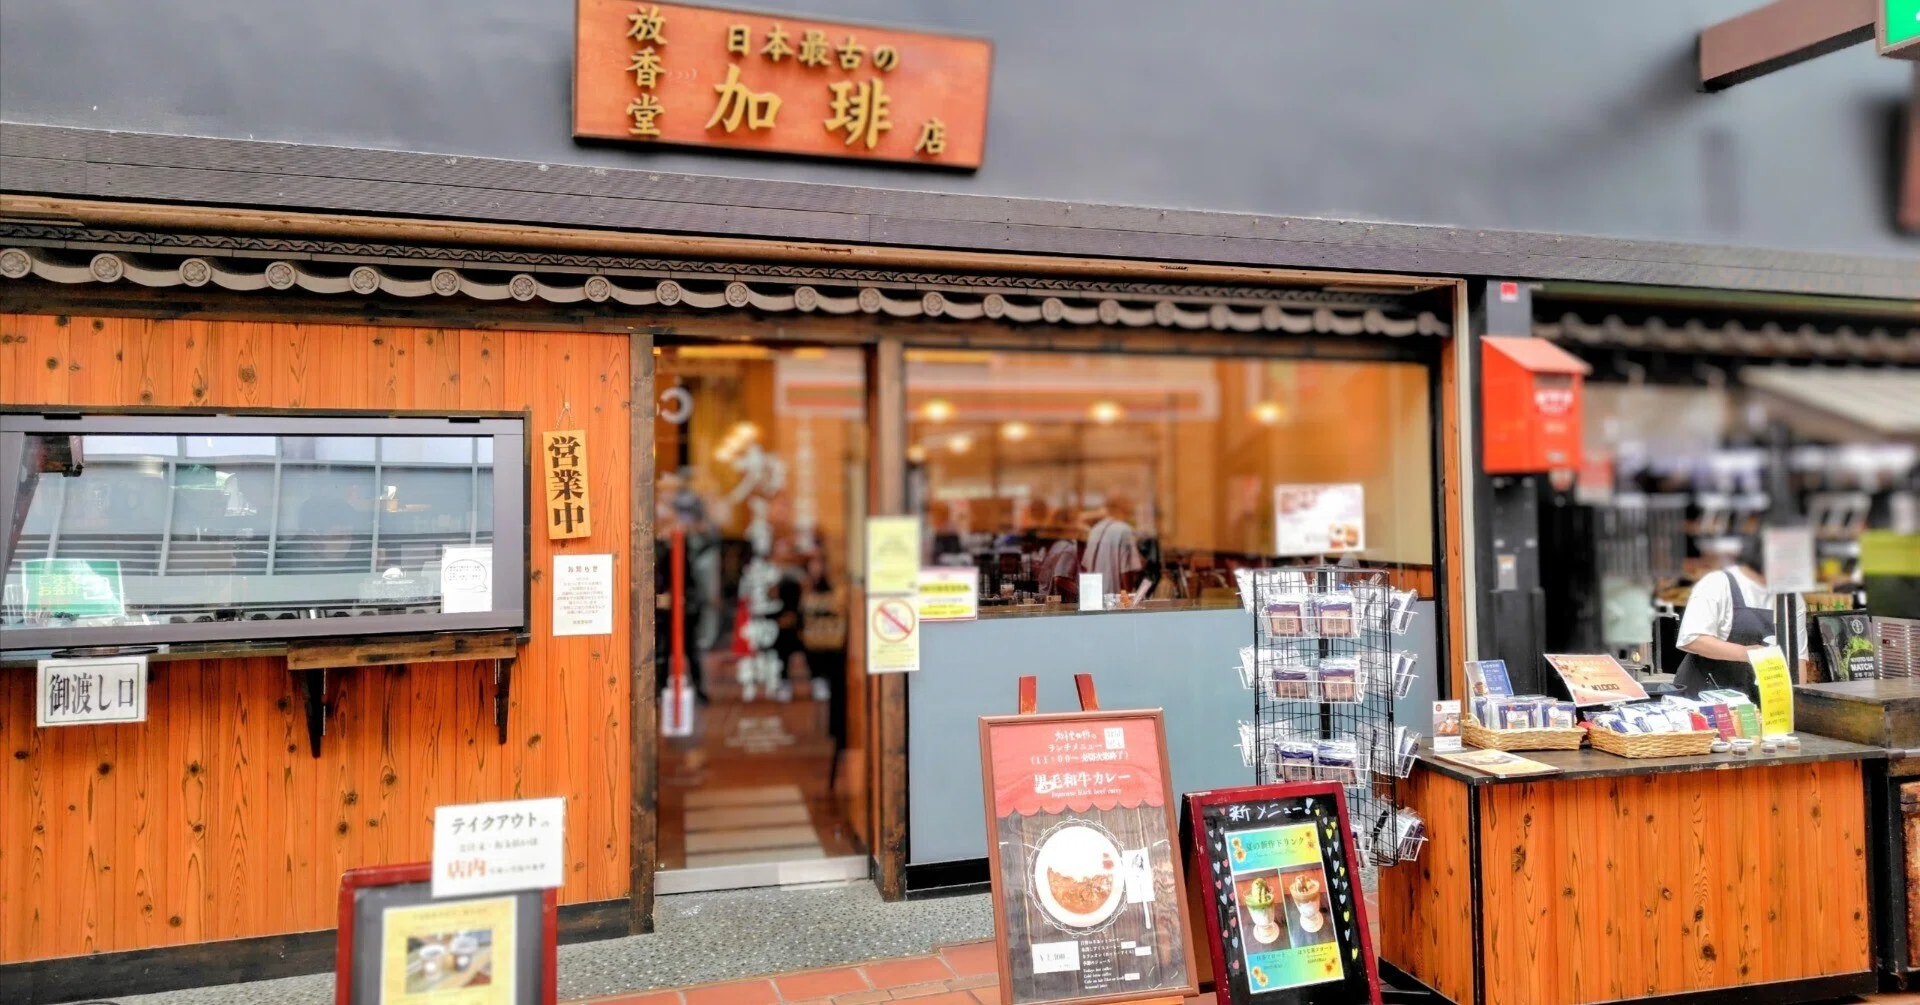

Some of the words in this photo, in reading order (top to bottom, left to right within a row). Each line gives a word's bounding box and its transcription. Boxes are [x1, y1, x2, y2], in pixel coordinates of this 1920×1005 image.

[727, 23, 898, 72] 日本最古の
[626, 5, 668, 137] 放香堂
[548, 436, 585, 534] 営業中
[568, 565, 598, 573] お知らせ
[49, 672, 134, 716] 御渡し口
[1034, 771, 1131, 792] 黒毛和牛カレー
